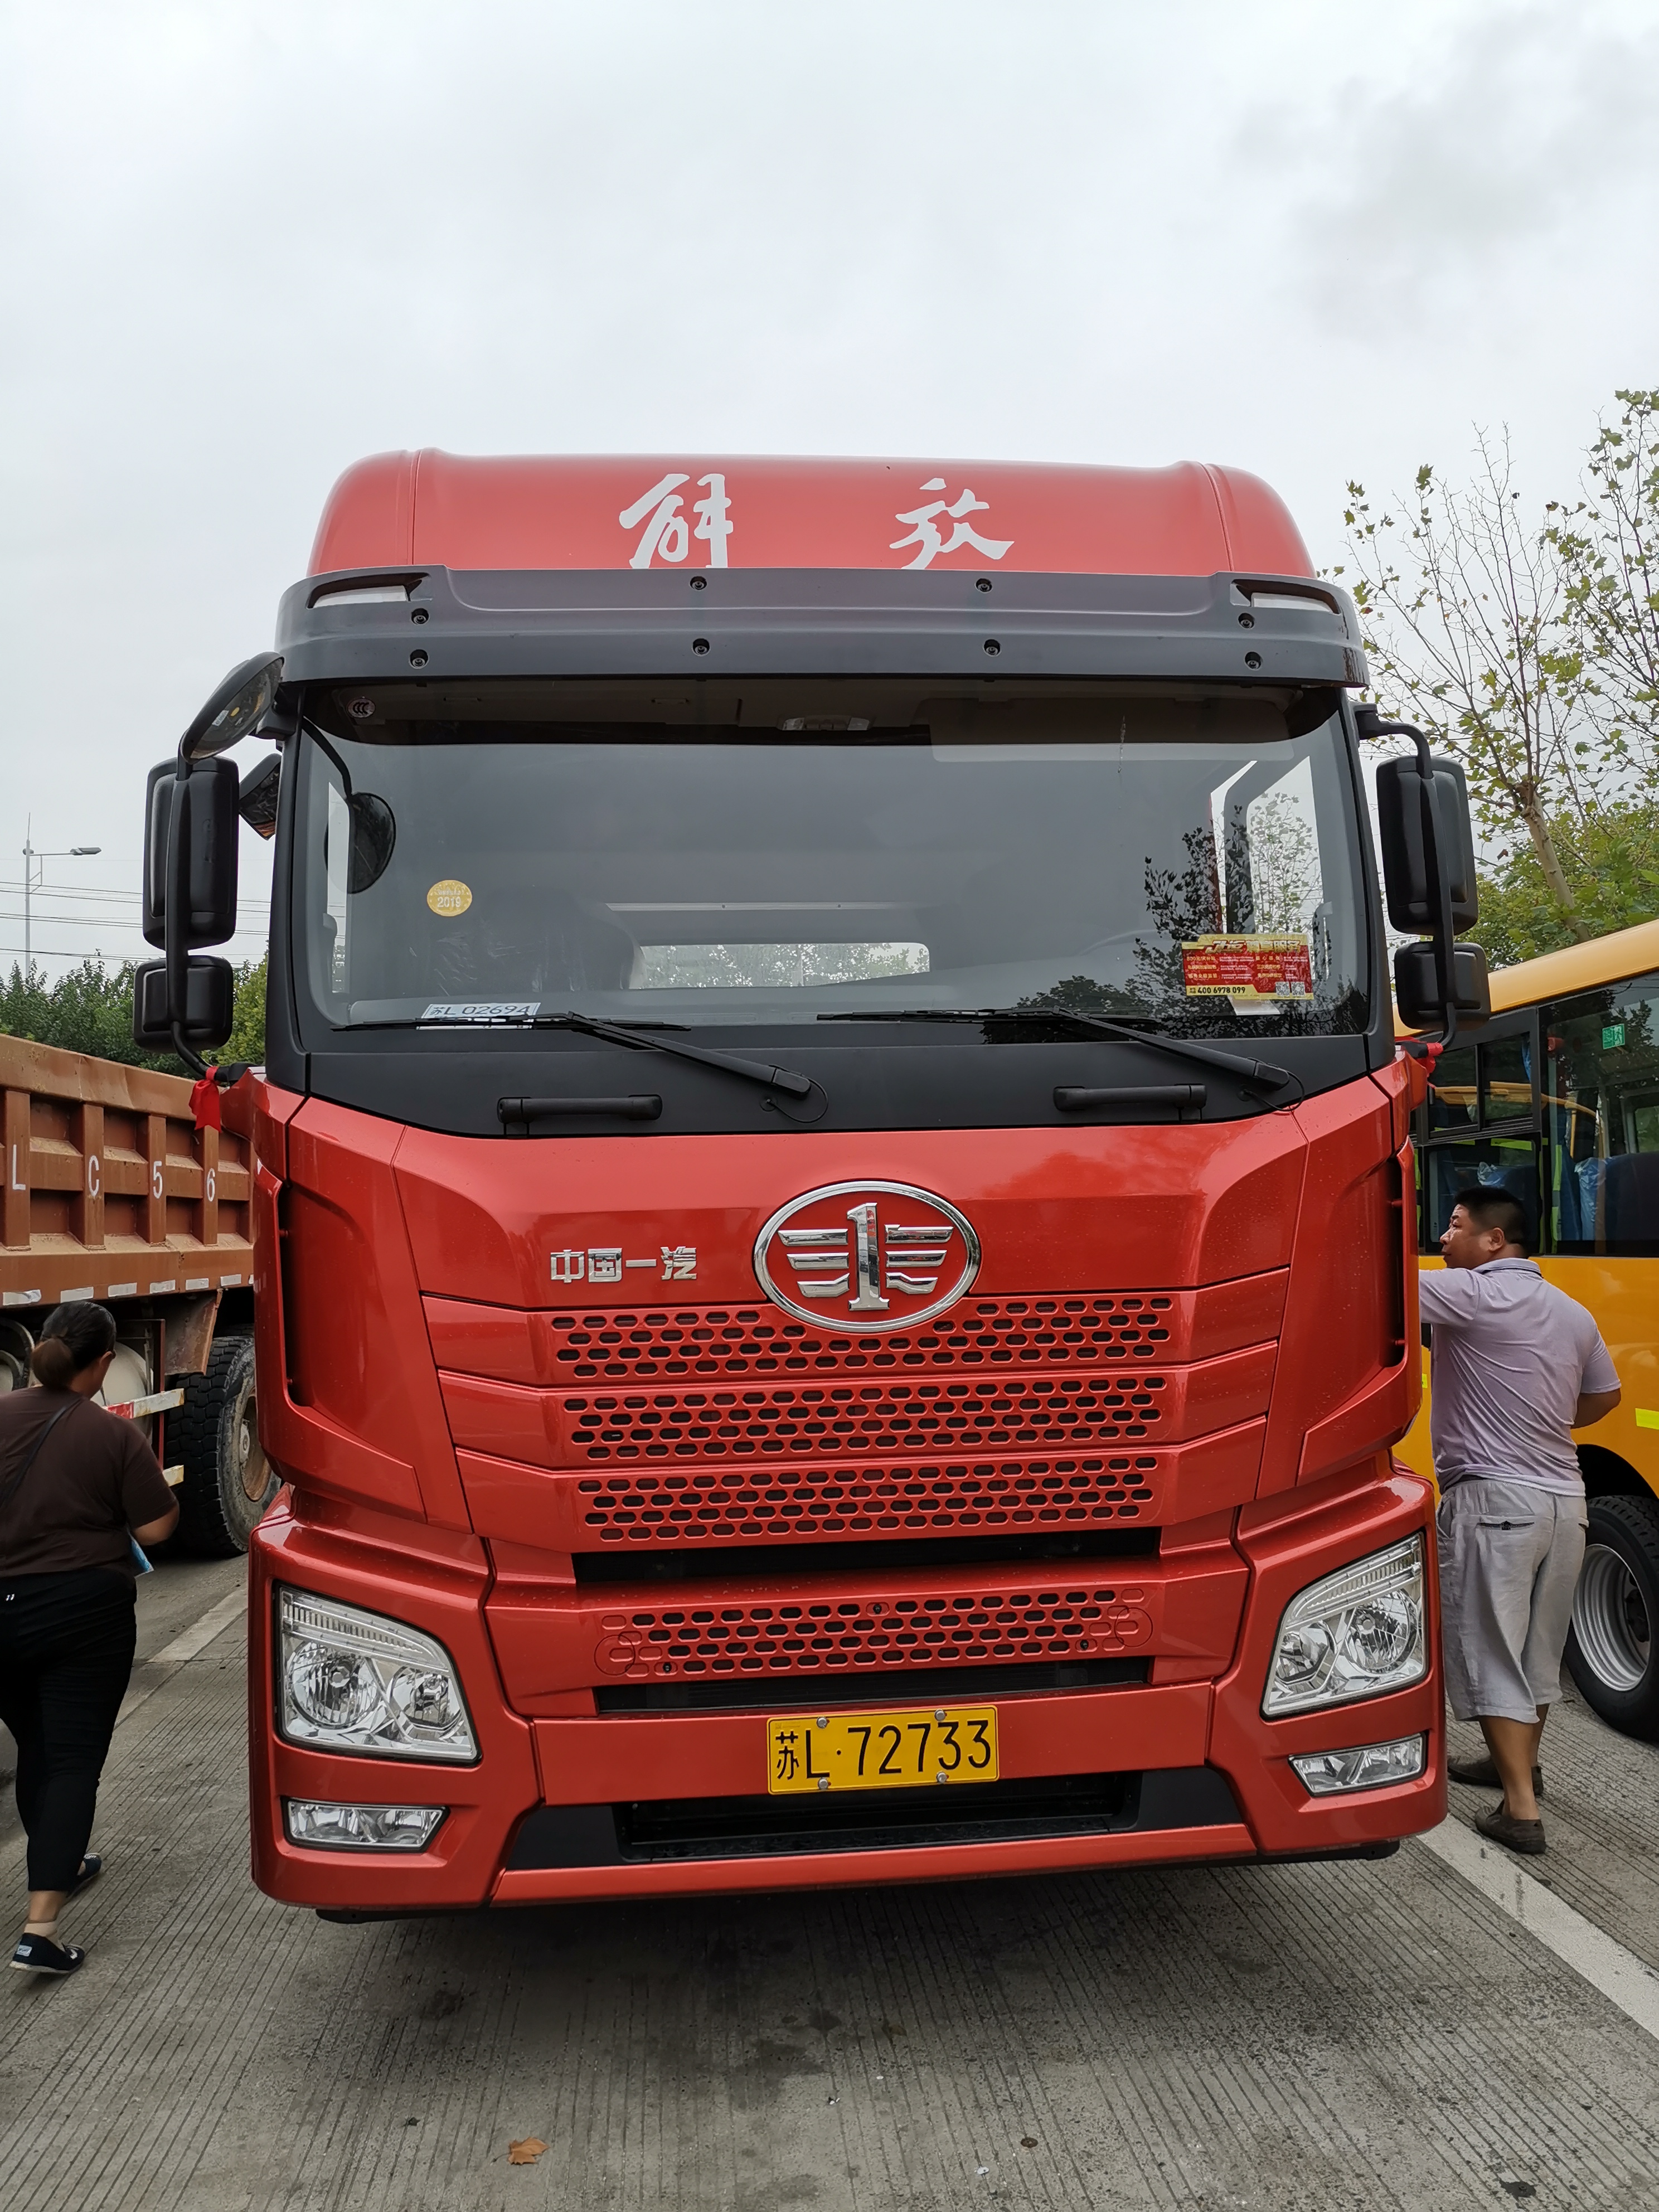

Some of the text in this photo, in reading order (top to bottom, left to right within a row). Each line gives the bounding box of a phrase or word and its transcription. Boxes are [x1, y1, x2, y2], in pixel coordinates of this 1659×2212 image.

[437, 896, 461, 908] 2019
[550, 1246, 697, 1283] 中国一汽
